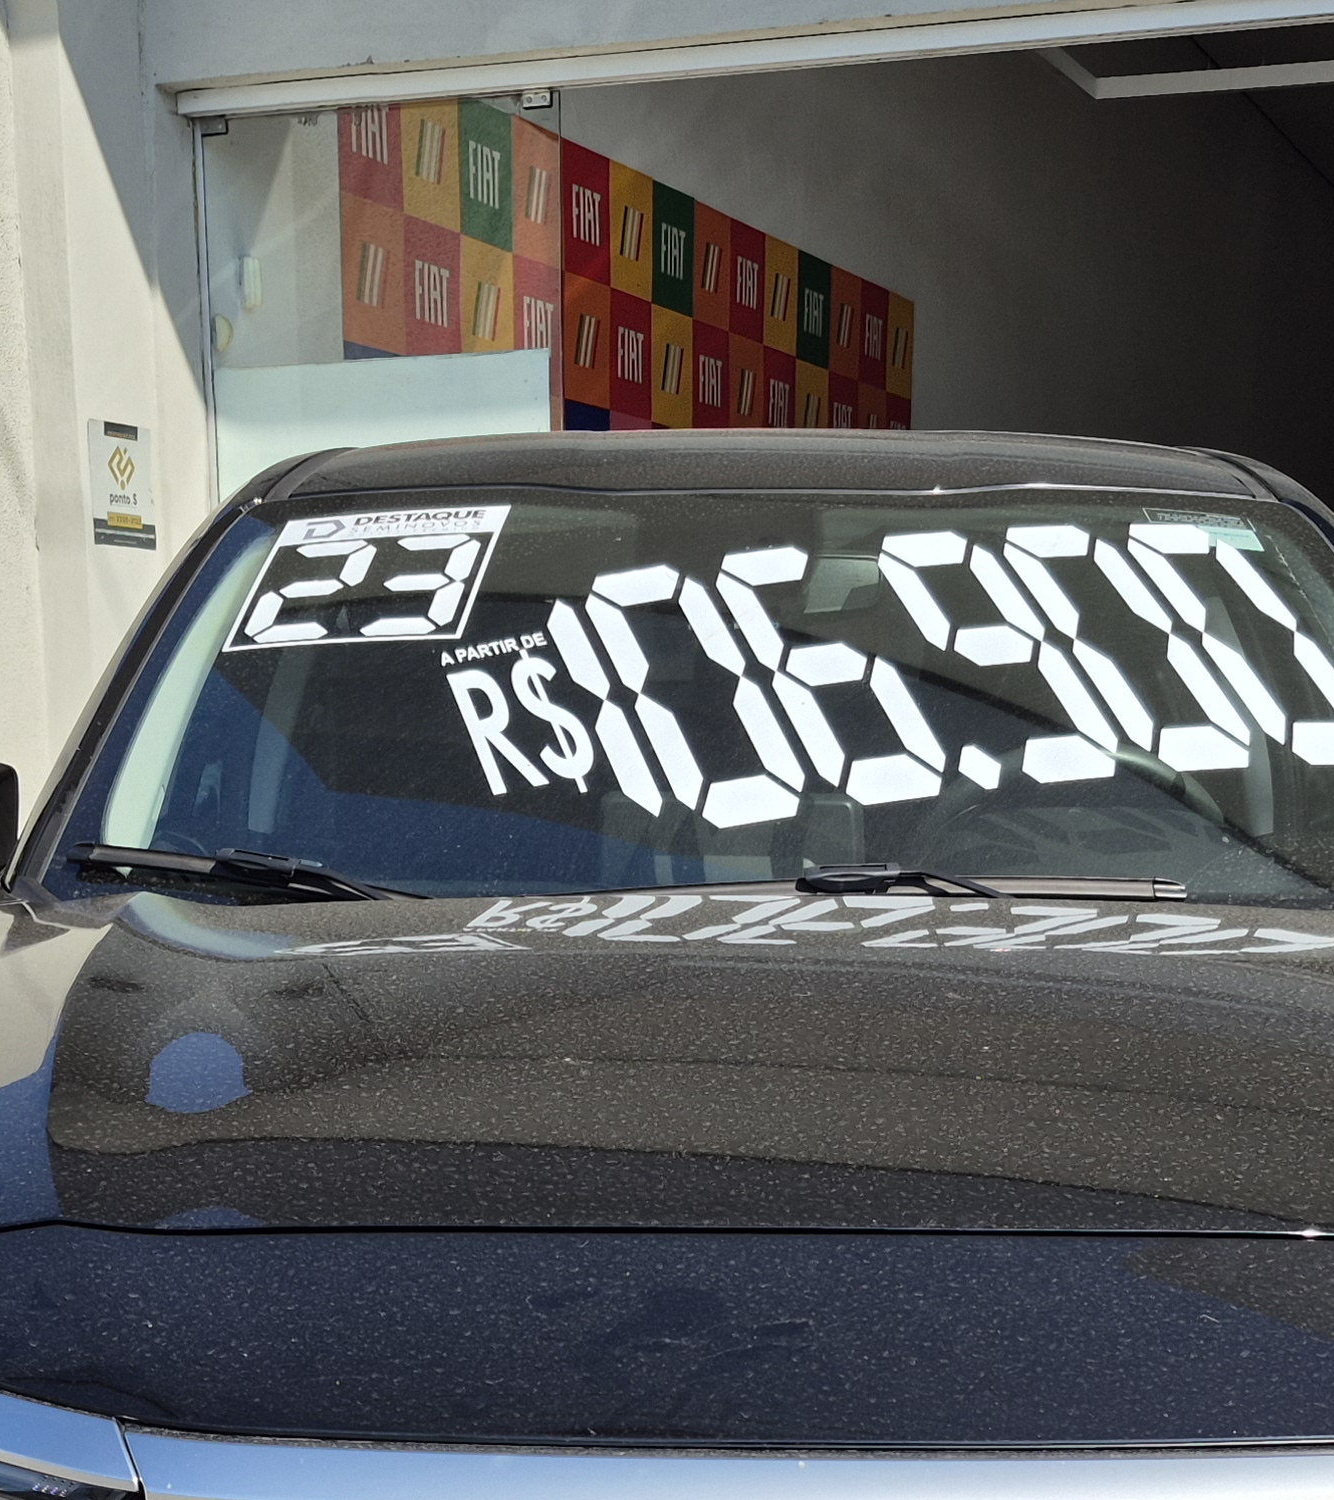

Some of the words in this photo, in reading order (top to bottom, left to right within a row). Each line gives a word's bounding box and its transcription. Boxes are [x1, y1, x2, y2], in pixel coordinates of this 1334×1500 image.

[468, 139, 501, 209] FIAT
[571, 183, 601, 246] FIAT
[660, 222, 686, 280] FIAT
[415, 259, 450, 328] FIAT
[736, 255, 759, 310] FIAT
[523, 295, 554, 350] FIAT
[803, 287, 824, 338] FIAT
[864, 313, 883, 361] FIAT
[617, 325, 644, 384] FIAT
[698, 354, 722, 408] FIAT
[768, 378, 790, 428] FIAT
[350, 518, 482, 534] SEMINOVOS
[353, 509, 487, 527] DESTAQUE
[244, 533, 481, 643] 23
[440, 649, 455, 667] A
[454, 636, 520, 665] PARTIR
[519, 631, 548, 652] DE
